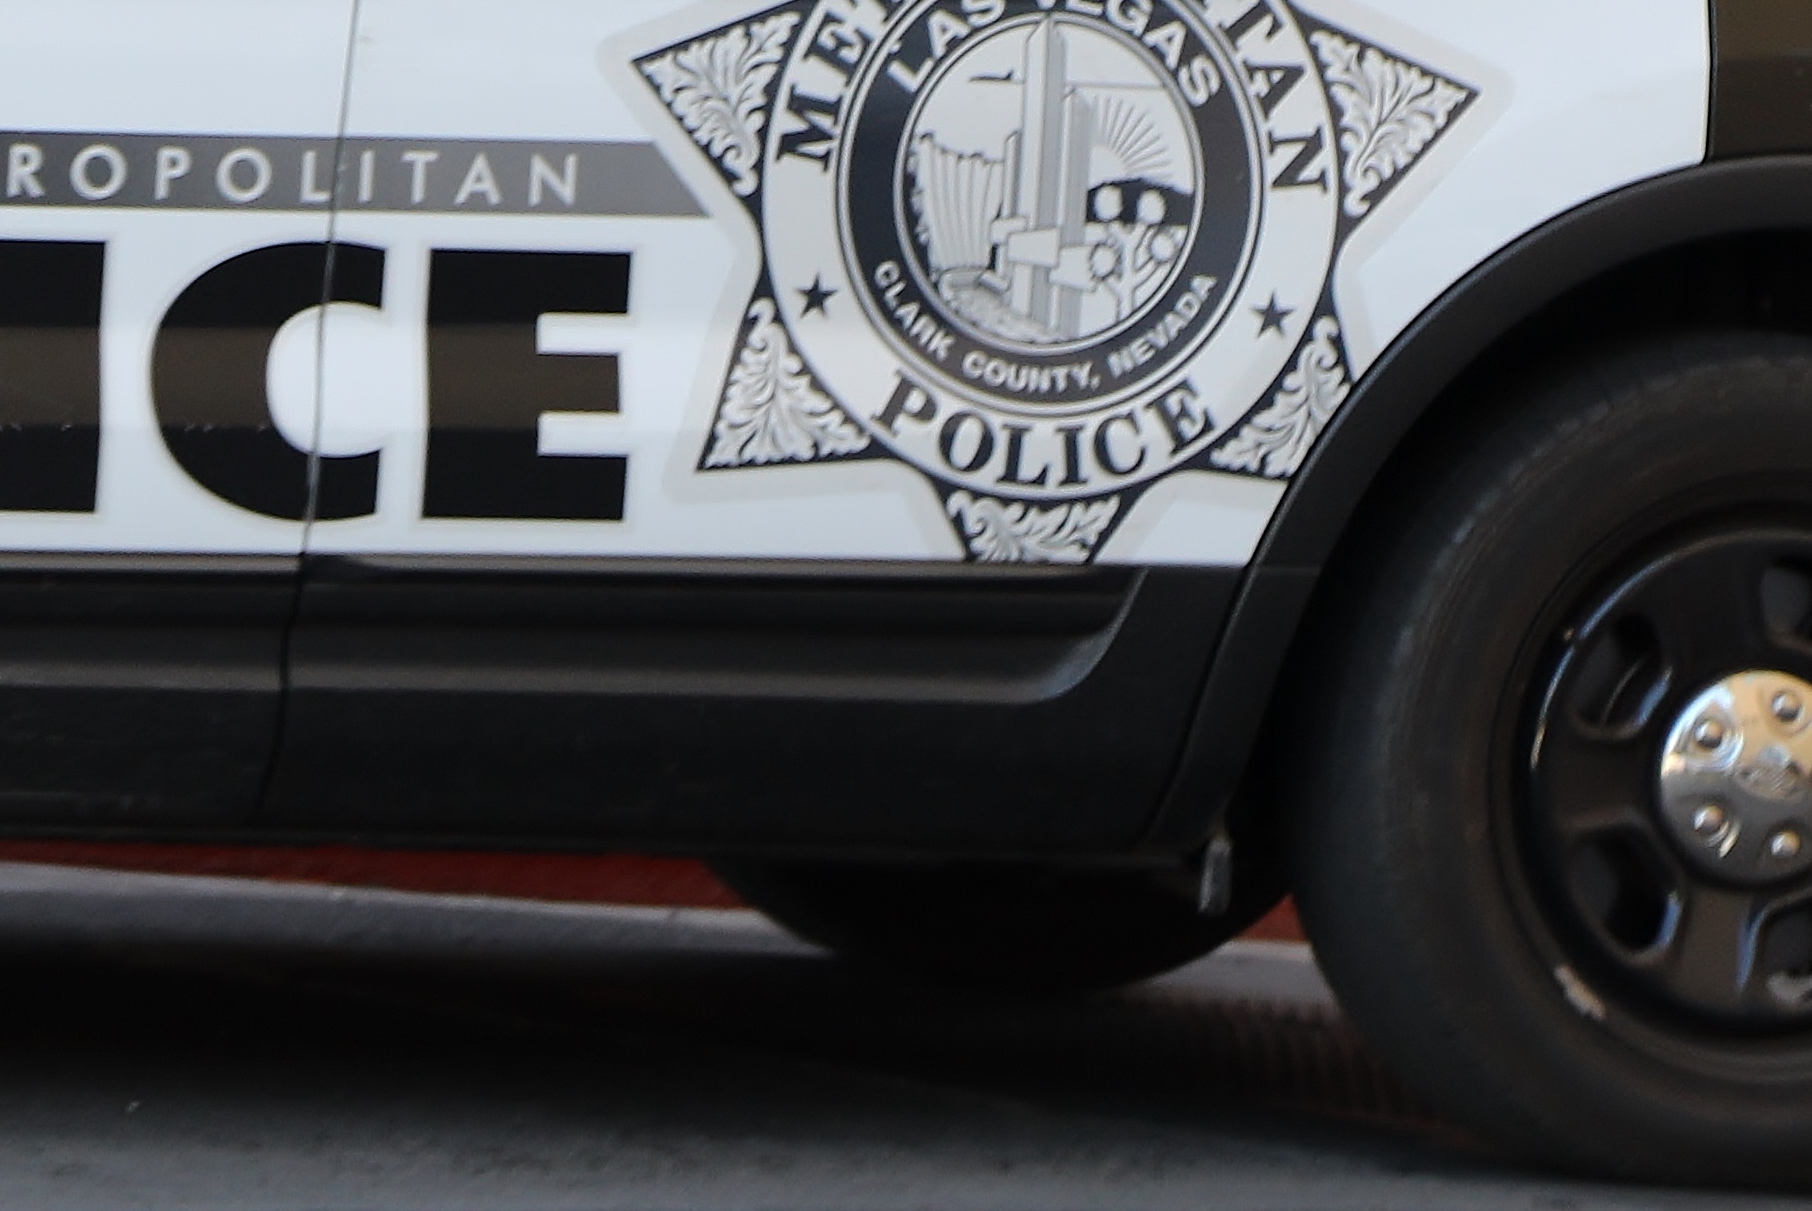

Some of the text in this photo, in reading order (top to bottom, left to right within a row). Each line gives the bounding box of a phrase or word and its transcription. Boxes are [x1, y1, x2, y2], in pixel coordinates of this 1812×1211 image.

[874, 260, 1217, 393] CLARK COUNTY, NEVADA
[871, 370, 1215, 485] POLICE
